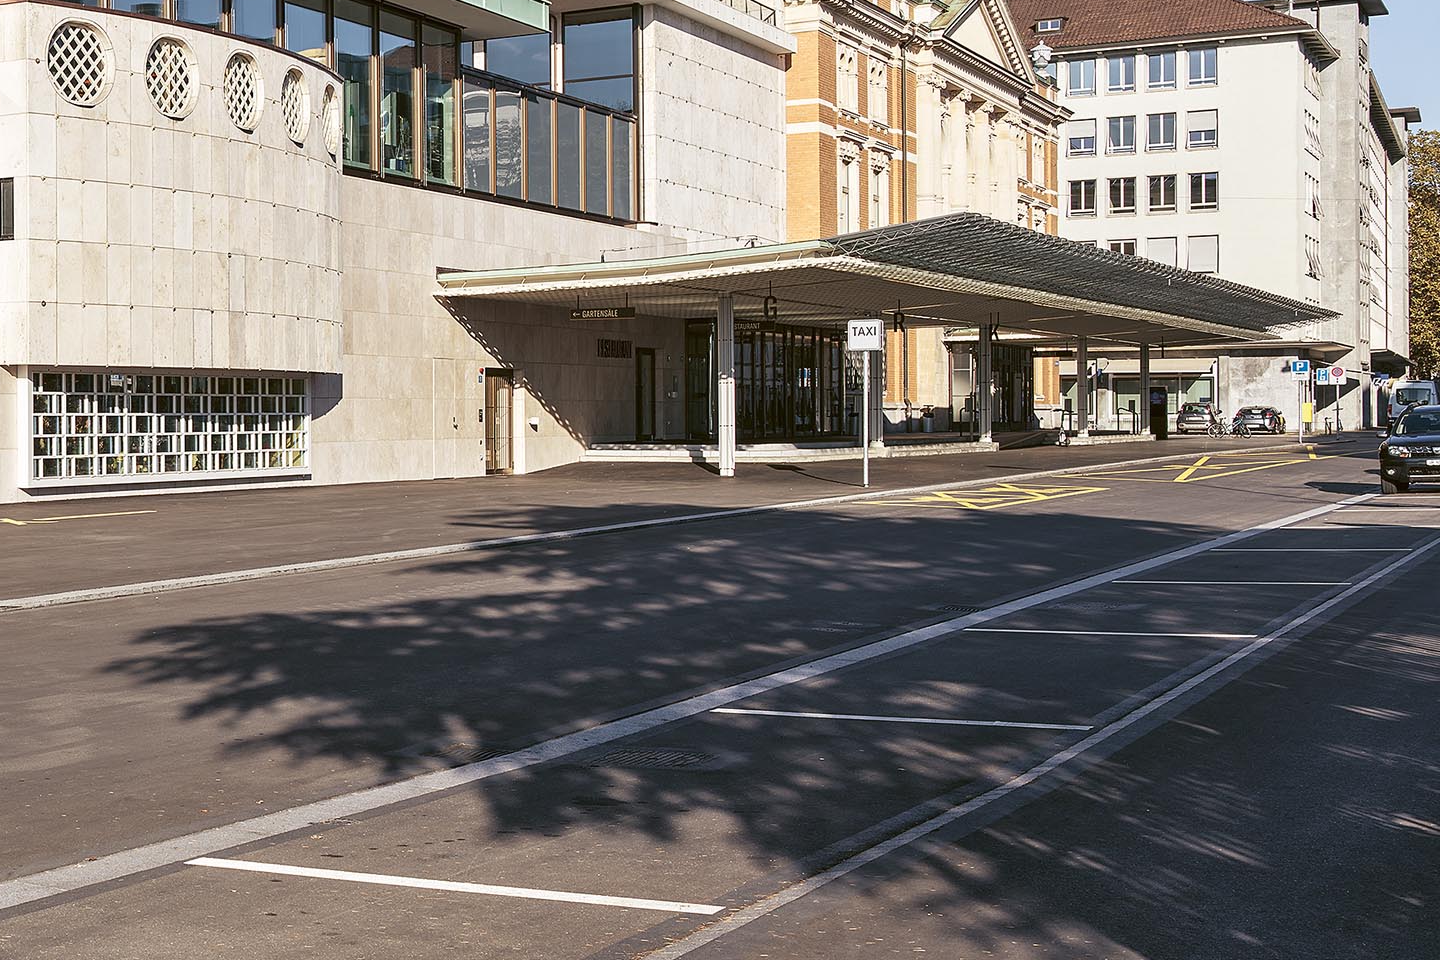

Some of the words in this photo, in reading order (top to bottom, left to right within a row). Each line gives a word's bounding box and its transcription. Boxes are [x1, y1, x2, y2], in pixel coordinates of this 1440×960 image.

[581, 308, 619, 318] GARTENSÄLE
[763, 296, 778, 320] G
[893, 312, 905, 332] R
[852, 326, 877, 337] TAXI
[1296, 362, 1304, 371] P
